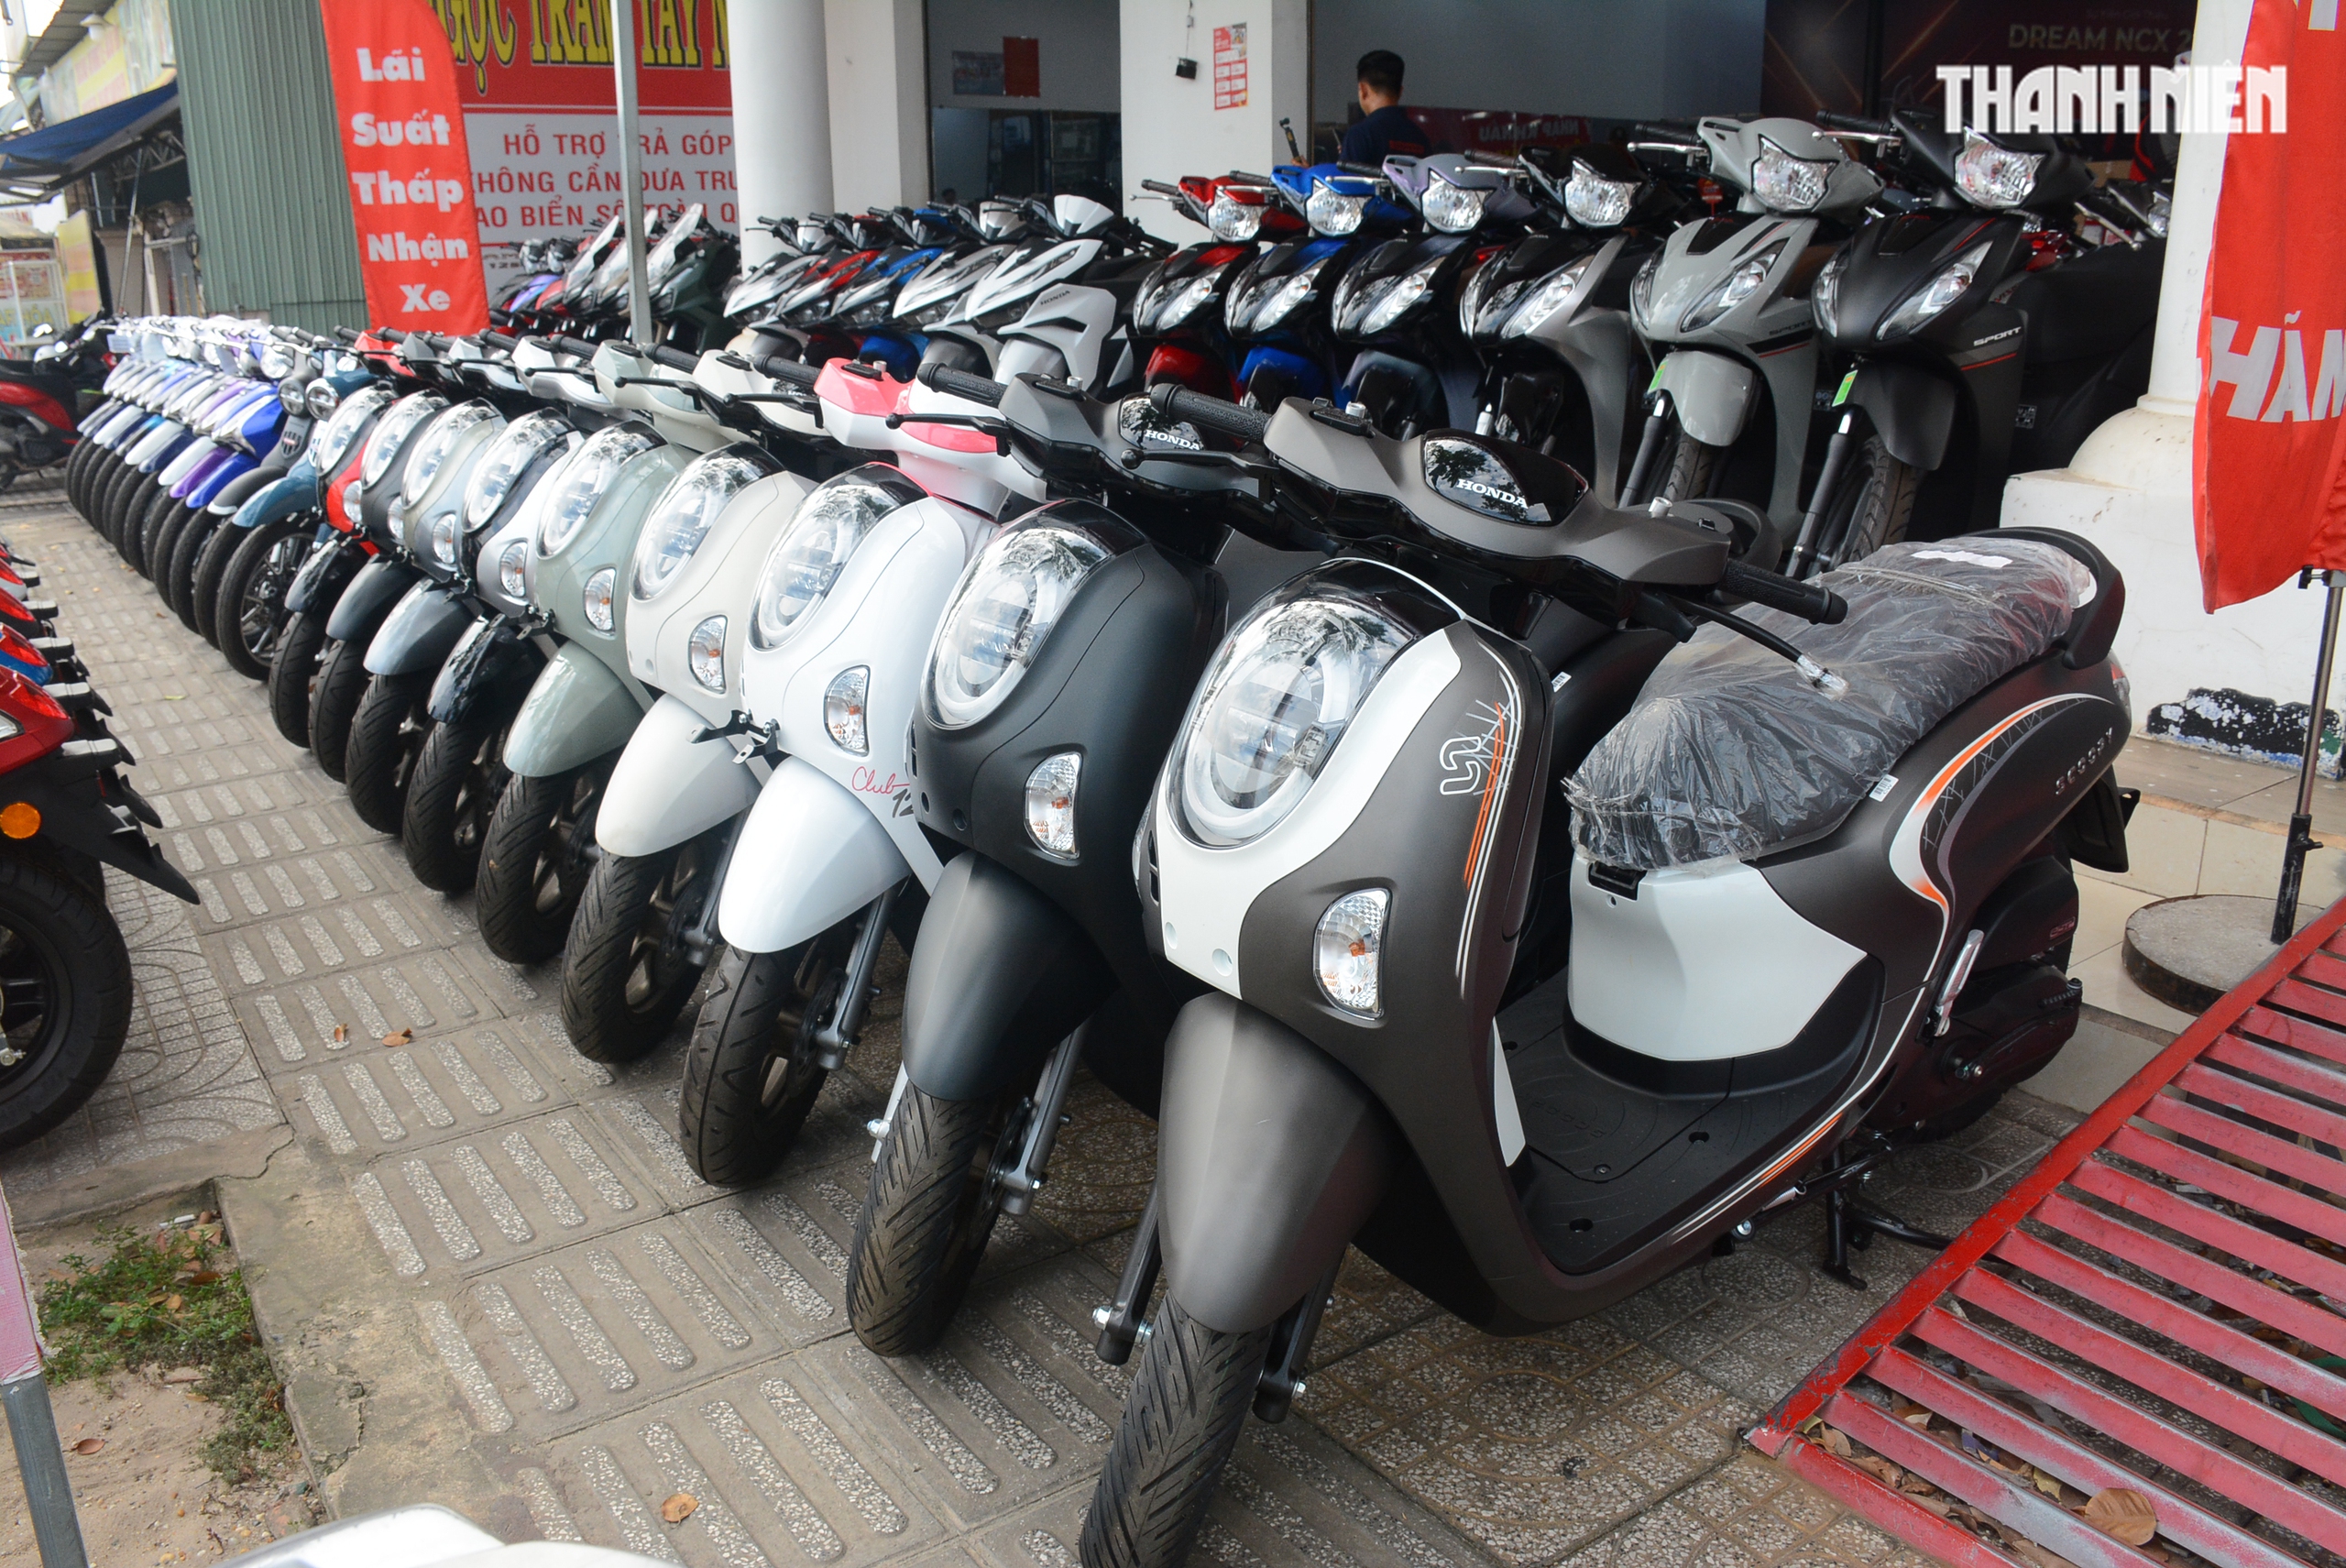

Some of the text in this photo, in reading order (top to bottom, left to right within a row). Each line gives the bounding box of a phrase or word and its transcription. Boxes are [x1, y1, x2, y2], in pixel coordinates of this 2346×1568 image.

[2010, 25, 2107, 49] DREAM
[356, 47, 425, 82] Lãi
[351, 109, 450, 147] Suất
[504, 123, 541, 156] HỖ
[554, 130, 606, 159] TRỢ
[681, 128, 732, 155] GÓP
[351, 168, 464, 212] Thấp
[472, 166, 554, 194] HÔNG
[568, 162, 621, 192] CẦN
[520, 194, 584, 227] BIỂN
[367, 231, 468, 267] Nhận
[399, 283, 451, 313] Xe
[1973, 326, 2022, 346] SPORT
[1145, 428, 1200, 451] HONDA
[1456, 478, 1529, 509] HONDA
[852, 766, 911, 794] Club
